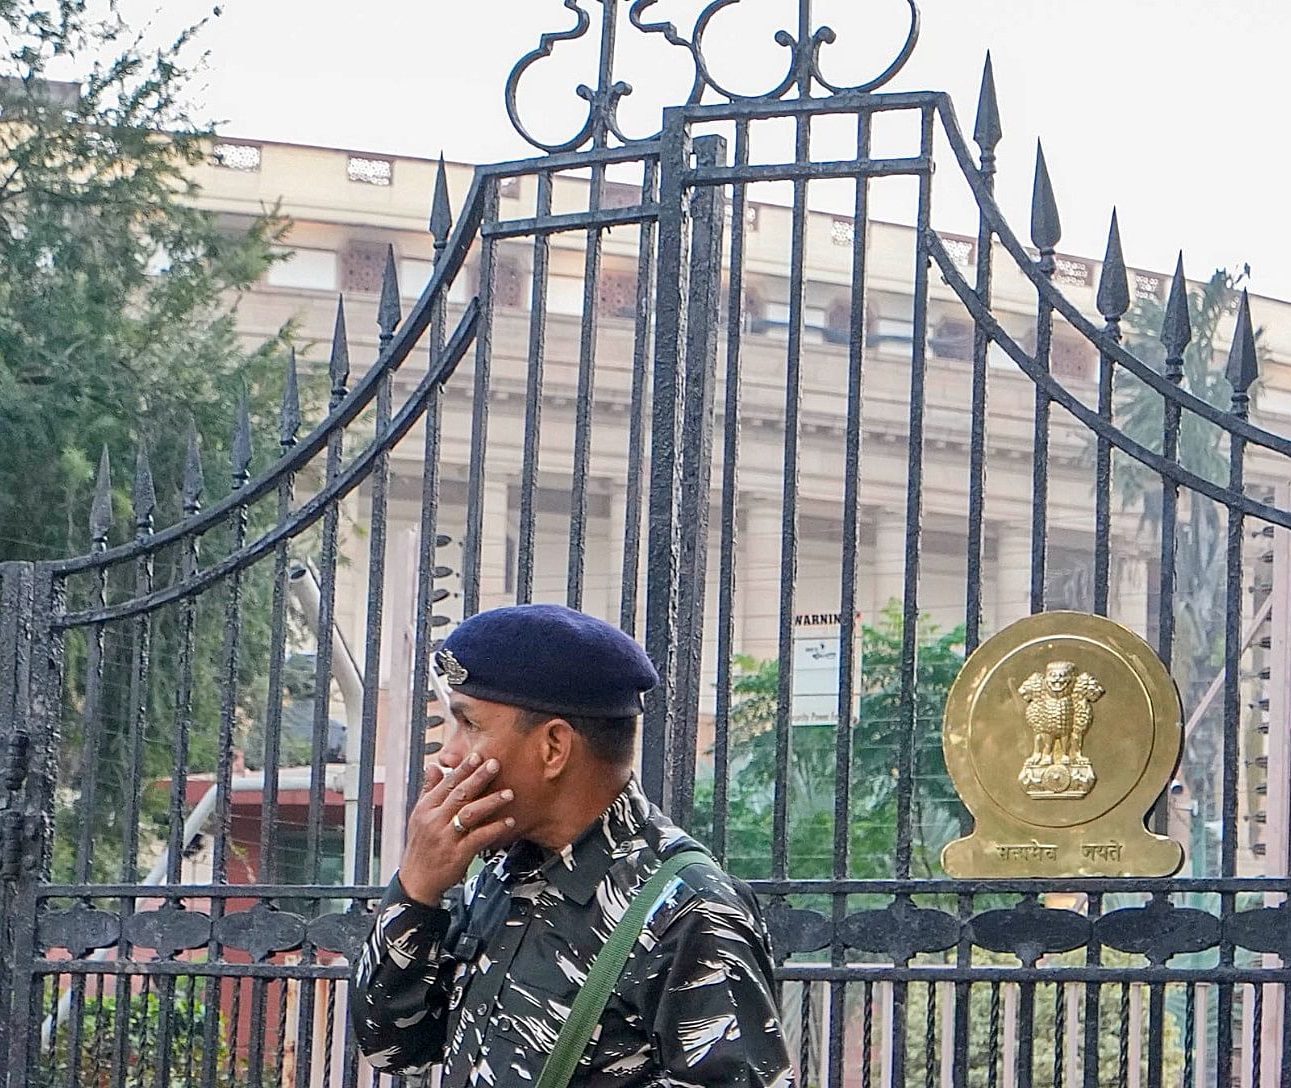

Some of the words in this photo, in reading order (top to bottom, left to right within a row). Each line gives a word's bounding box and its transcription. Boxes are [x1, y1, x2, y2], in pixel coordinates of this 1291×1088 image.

[795, 614, 841, 626] WARNIN
[996, 839, 1059, 862] सत्यमेव
[1082, 839, 1123, 862] जयते
